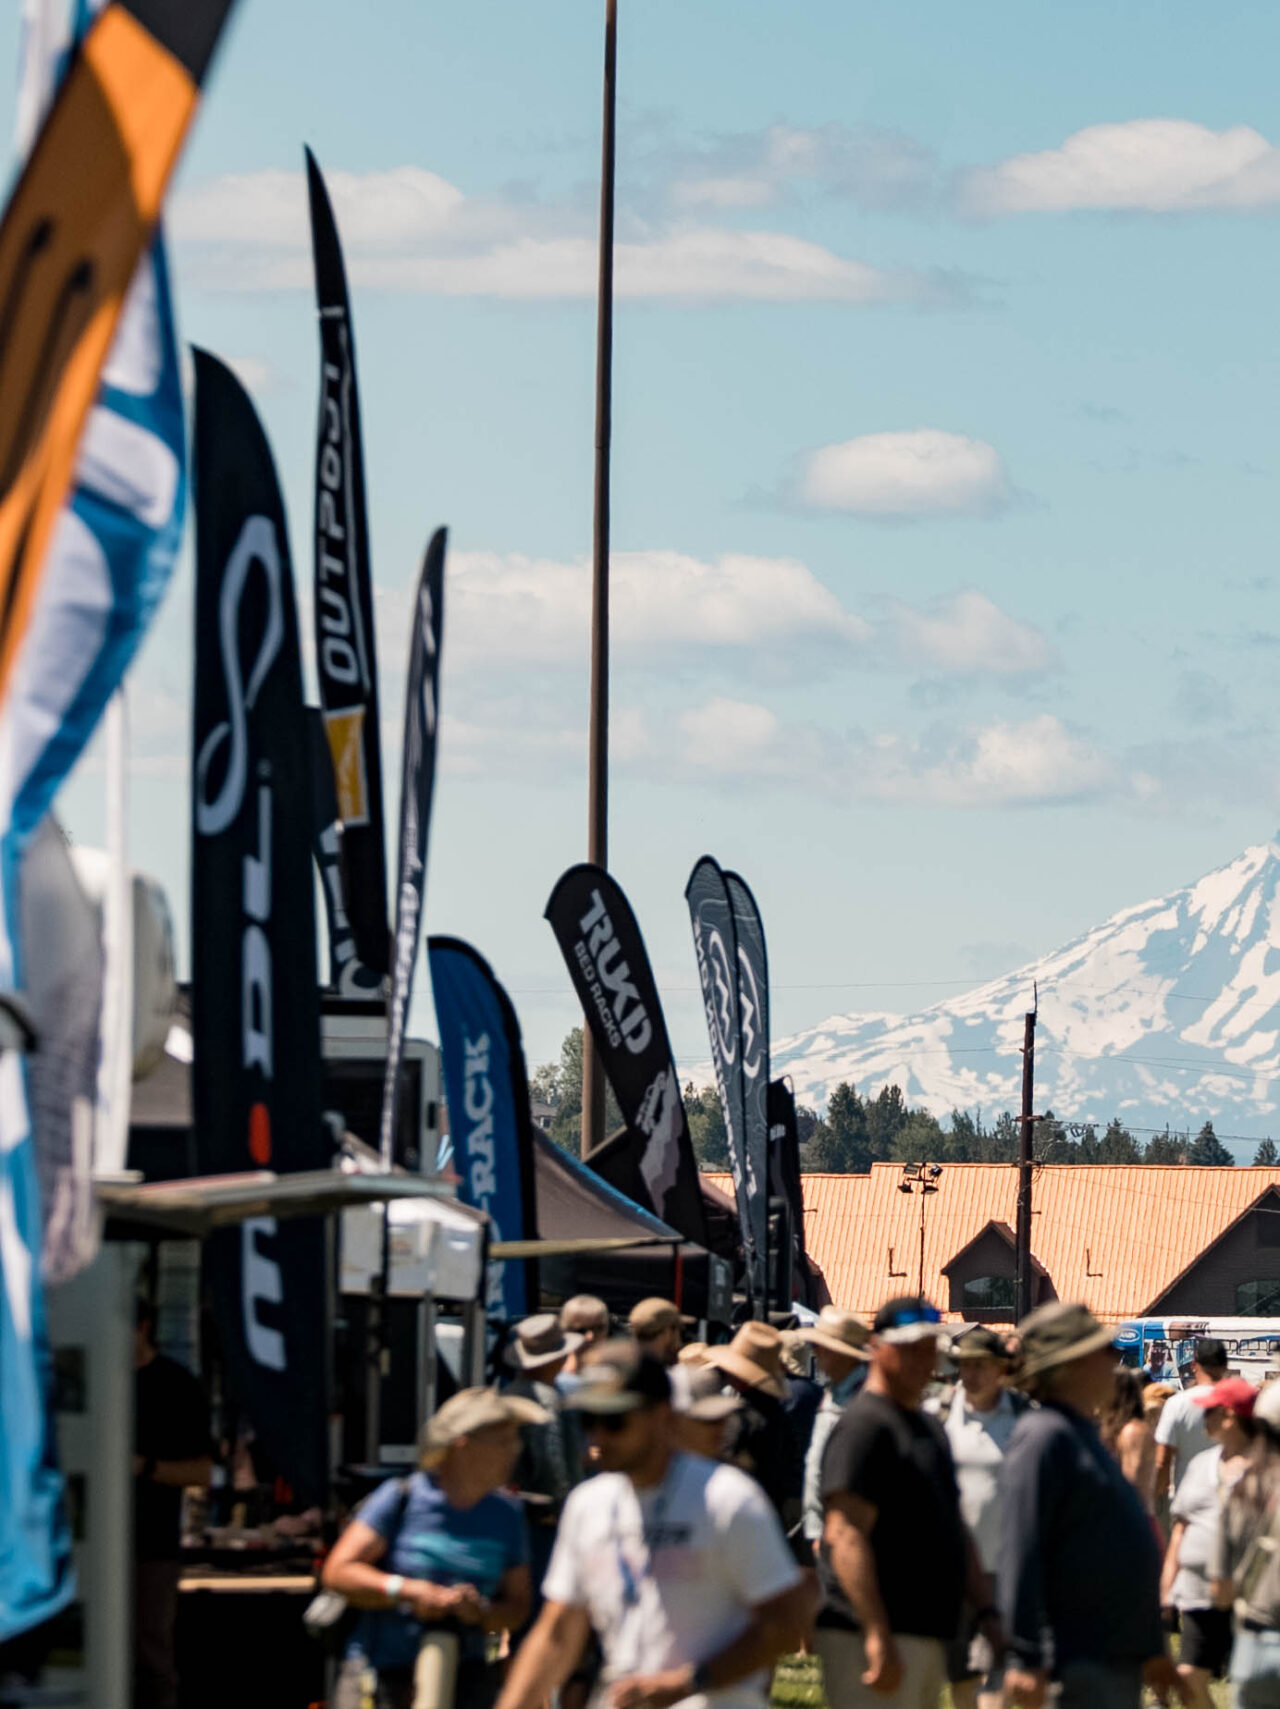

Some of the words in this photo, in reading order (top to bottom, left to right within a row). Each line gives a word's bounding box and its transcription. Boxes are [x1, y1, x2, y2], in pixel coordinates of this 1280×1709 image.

[573, 939, 597, 980] BED
[589, 983, 623, 1049] RACKS
[579, 887, 653, 1055] TRUKD
